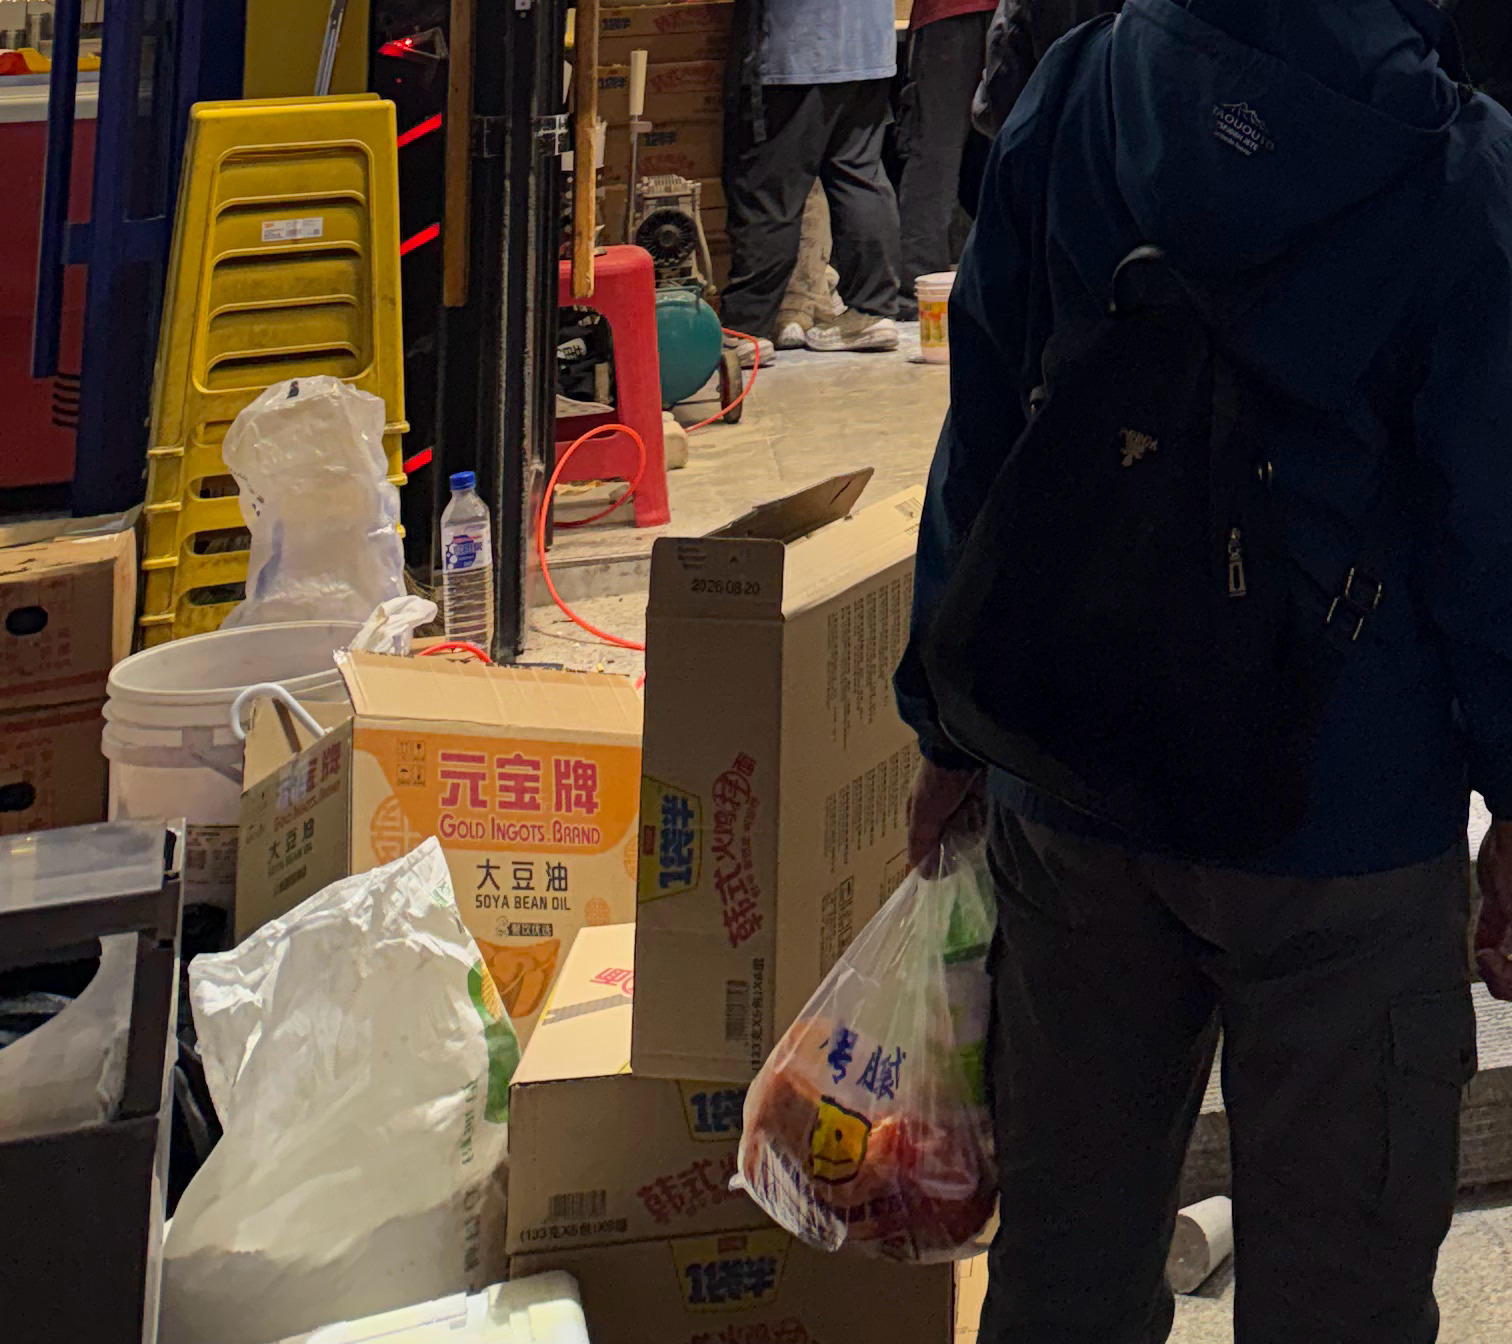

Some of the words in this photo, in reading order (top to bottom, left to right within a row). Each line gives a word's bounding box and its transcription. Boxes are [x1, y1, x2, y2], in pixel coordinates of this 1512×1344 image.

[439, 751, 602, 815] 元宝牌
[475, 857, 570, 893] 大豆油
[475, 894, 510, 910] SOYA
[513, 894, 548, 911] BEAN
[551, 896, 571, 912] OIL
